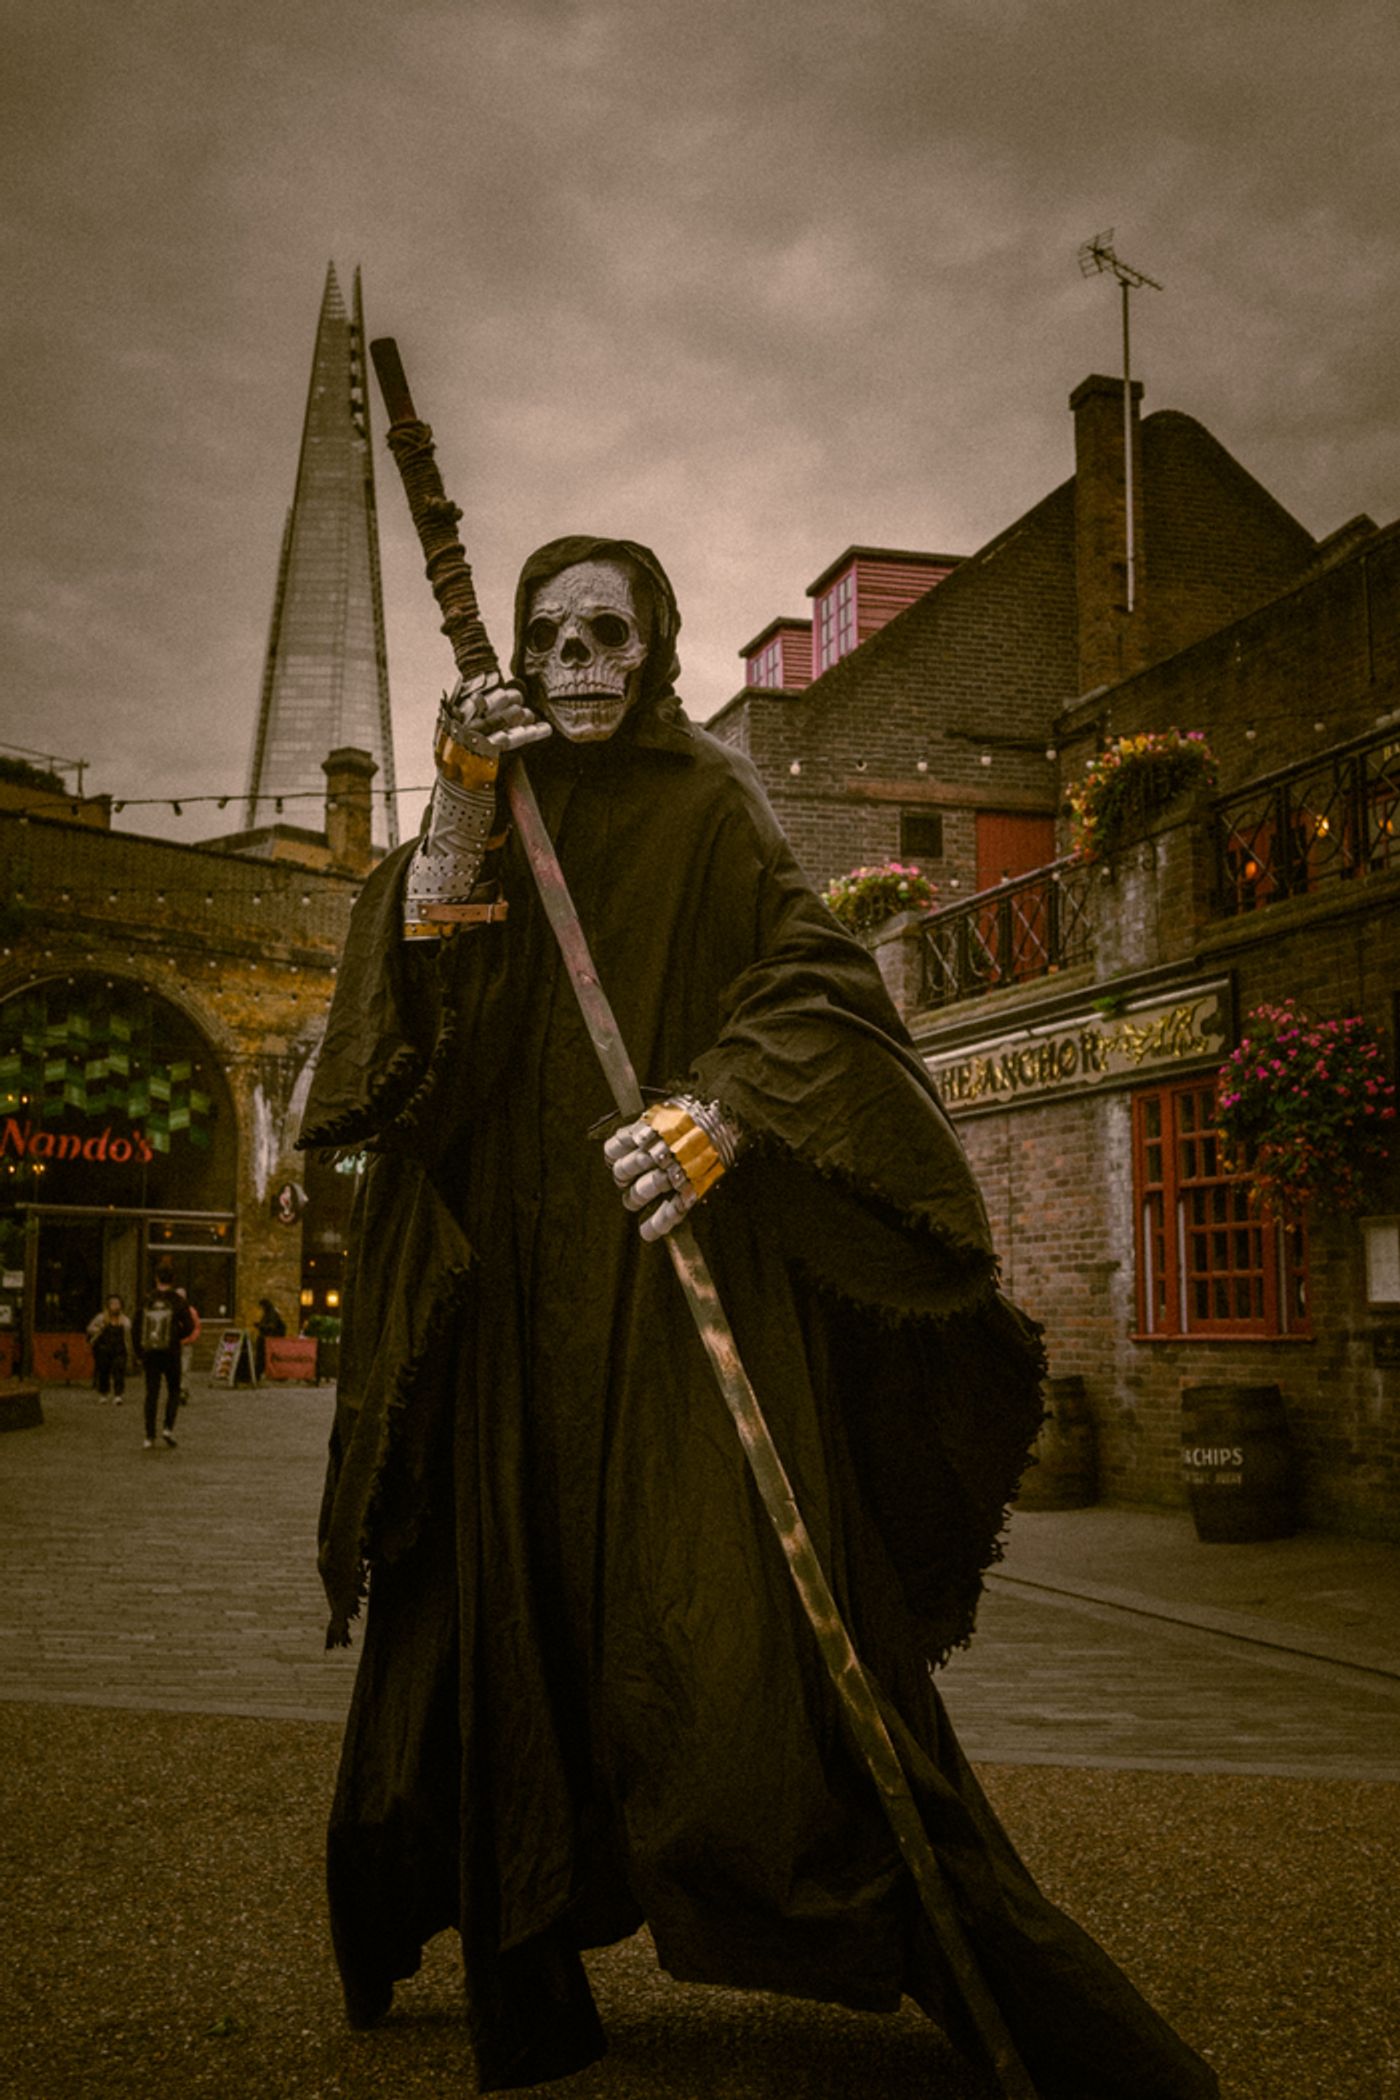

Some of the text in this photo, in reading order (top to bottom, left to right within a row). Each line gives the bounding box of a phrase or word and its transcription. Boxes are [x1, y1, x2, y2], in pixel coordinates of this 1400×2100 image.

[934, 1065, 973, 1101] HE
[977, 1029, 1104, 1093] ANCHOR
[0, 1117, 153, 1162] Nando's
[1192, 1446, 1244, 1468] CHIPS
